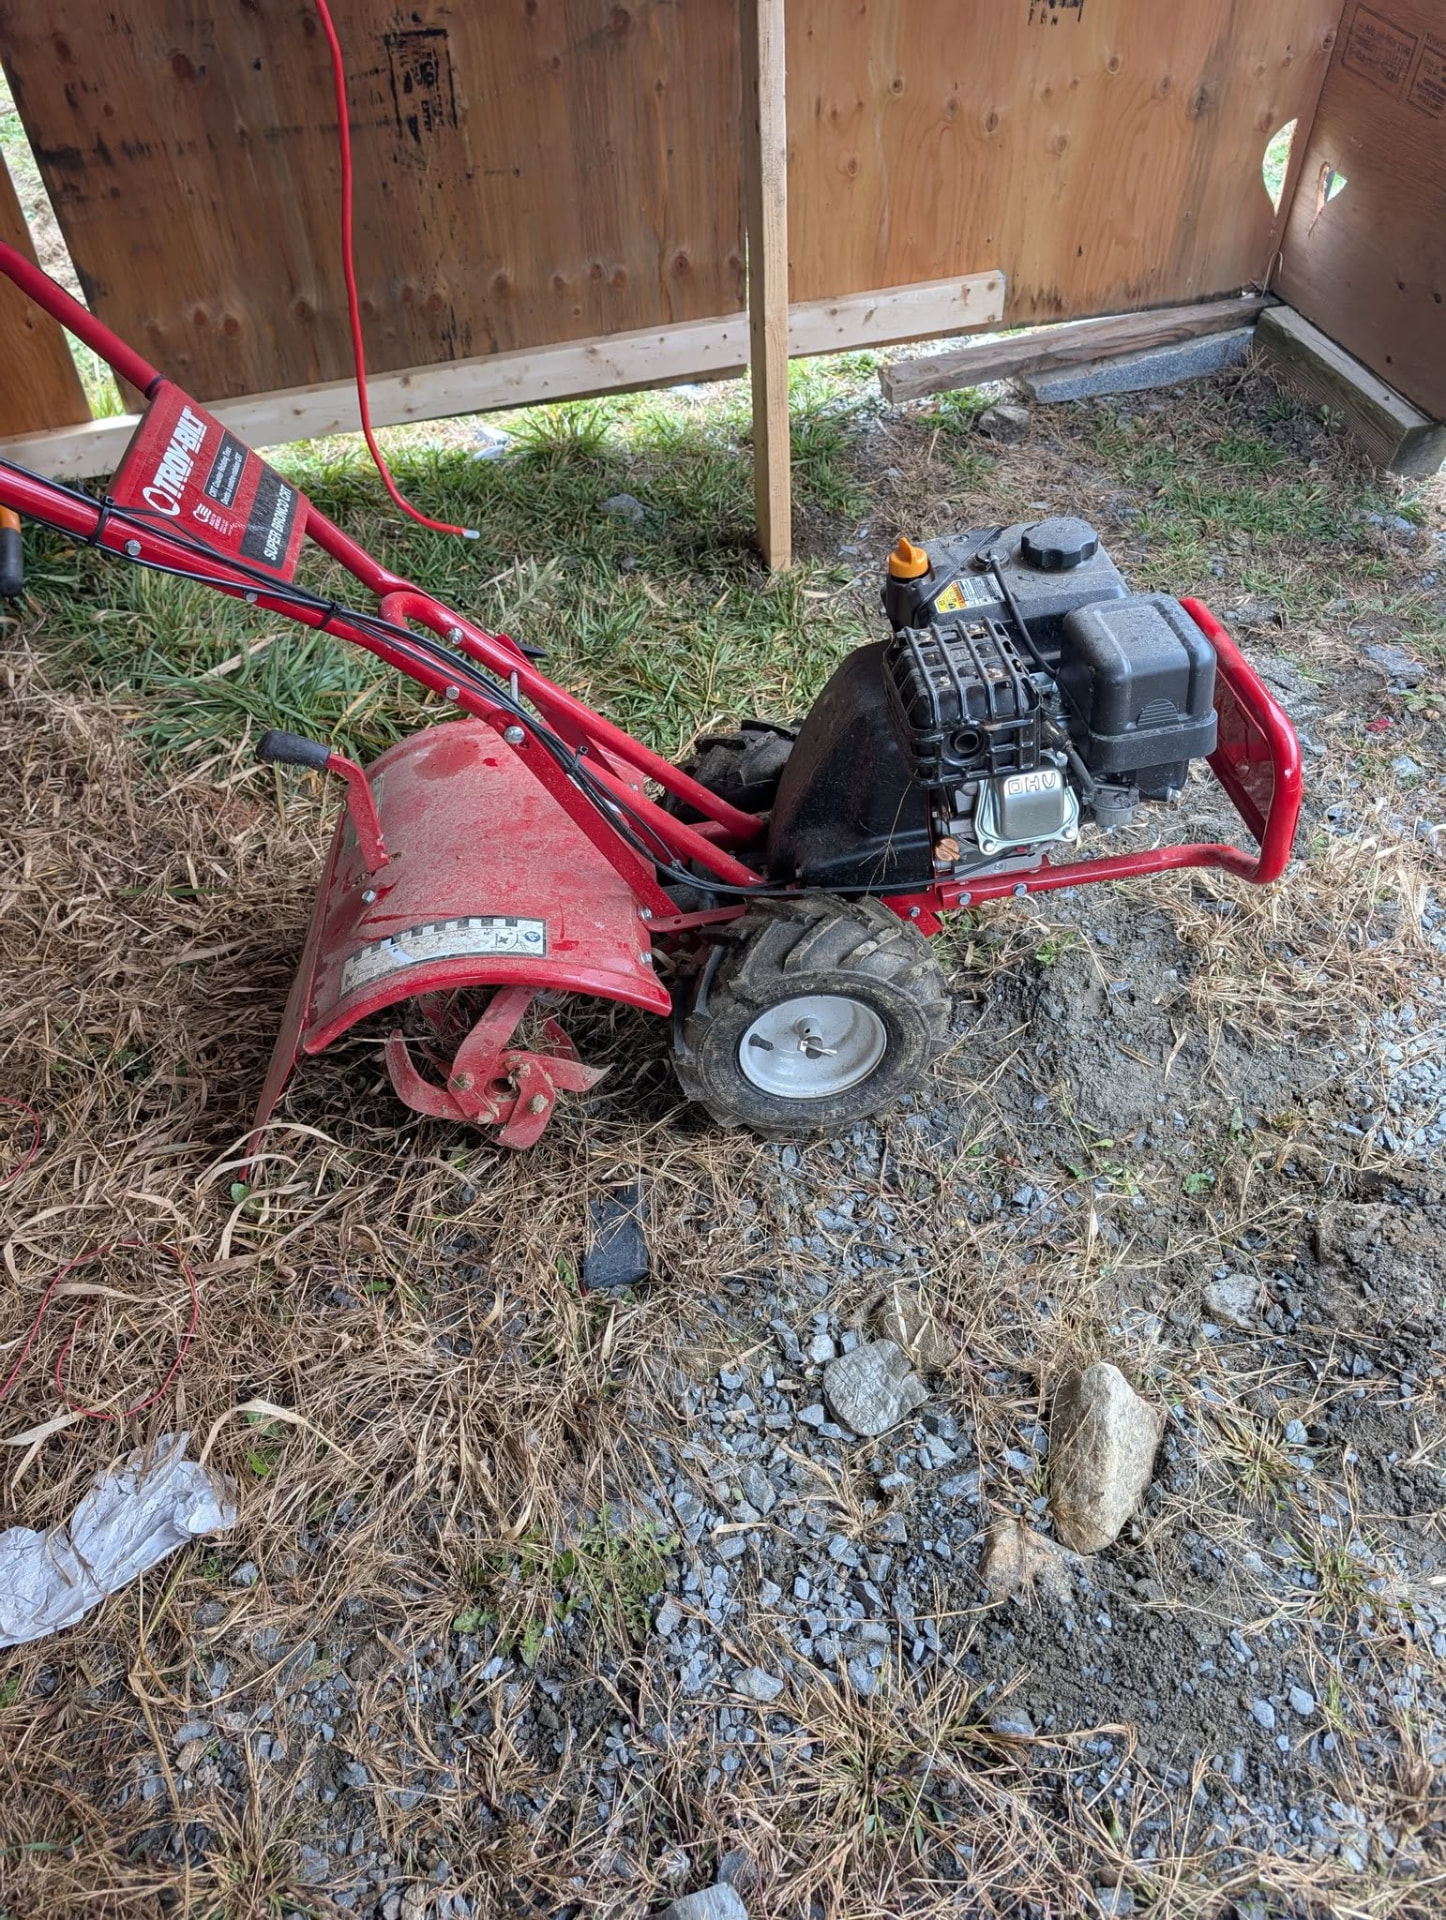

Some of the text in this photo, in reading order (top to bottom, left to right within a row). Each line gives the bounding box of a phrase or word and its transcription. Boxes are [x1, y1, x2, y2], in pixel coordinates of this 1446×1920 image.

[153, 406, 207, 499] TROY-BILT
[209, 485, 218, 498] CRT
[263, 484, 293, 561] SUPER BRONCO CRT
[1008, 772, 1057, 795] OHV
